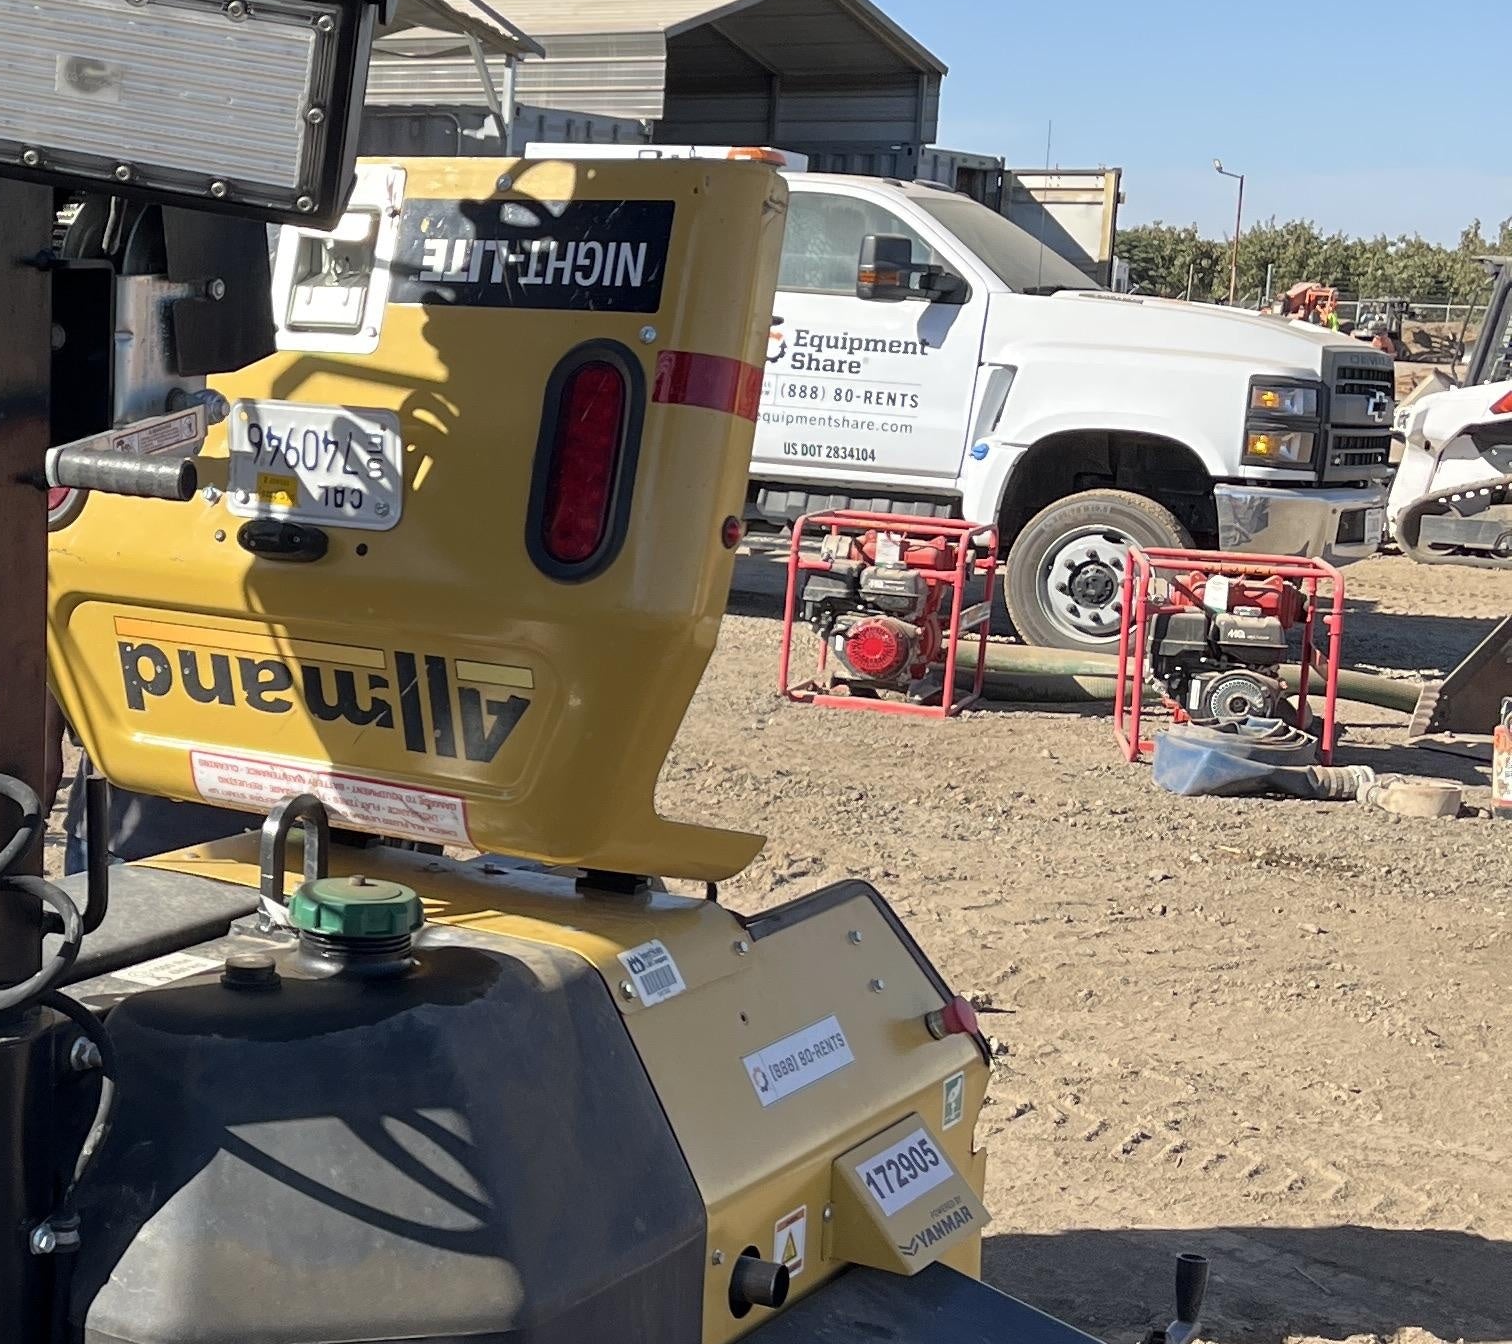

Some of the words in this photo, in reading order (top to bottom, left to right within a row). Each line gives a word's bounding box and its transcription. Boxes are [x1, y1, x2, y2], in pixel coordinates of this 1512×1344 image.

[418, 238, 648, 288] NIGHT-LITE
[793, 329, 929, 356] Equipment
[790, 352, 862, 374] Share
[780, 383, 826, 402] (888)
[832, 388, 919, 409] 80-RENTS
[248, 423, 358, 475] 740946
[783, 441, 798, 455] US
[801, 443, 823, 457] DOT
[825, 445, 877, 462] 2834104
[319, 485, 363, 510] CAL
[117, 640, 532, 763] Allmand
[798, 1032, 846, 1068] 80-RENTS
[865, 1138, 940, 1200] 172905
[915, 1205, 974, 1248] YANMAR
